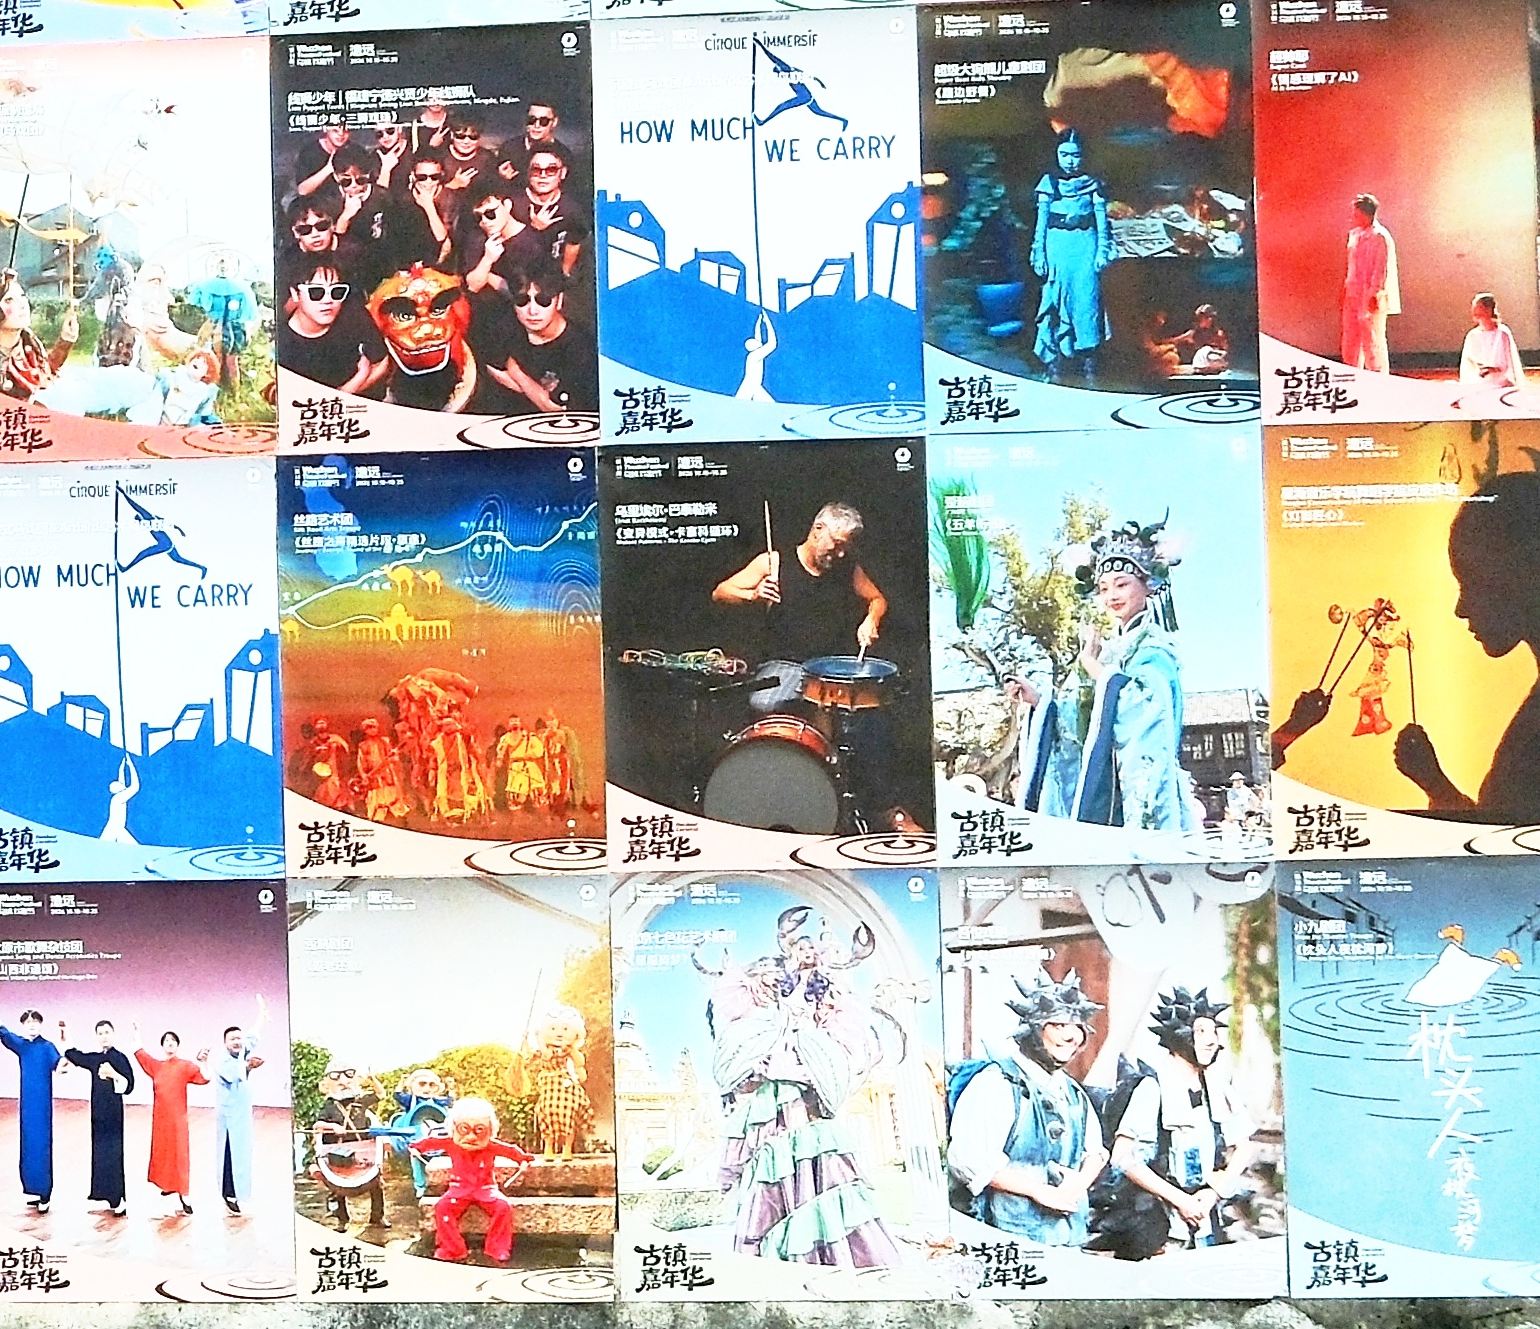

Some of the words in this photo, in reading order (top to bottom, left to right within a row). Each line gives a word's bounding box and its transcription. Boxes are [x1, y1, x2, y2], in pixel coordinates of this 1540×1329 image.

[620, 120, 674, 143] HOW
[691, 117, 754, 141] MUCH
[765, 138, 800, 162] WE
[817, 135, 895, 161] CARRY
[1275, 365, 1329, 390] 古镇
[614, 386, 666, 410] 古镇
[1277, 387, 1358, 416] 嘉年华
[616, 407, 694, 435] 嘉年华
[57, 563, 118, 587] MUCH
[127, 585, 161, 608] WE
[177, 583, 253, 607] CARRY
[298, 820, 350, 844] 古镇
[950, 808, 1004, 833] 古镇
[300, 841, 378, 869] 嘉年华
[952, 830, 1033, 859] 嘉年华
[634, 1244, 686, 1267] 古镇
[1303, 1239, 1359, 1263] 古镇
[636, 1266, 714, 1292] 嘉年华
[1305, 1262, 1389, 1289] 嘉年华
